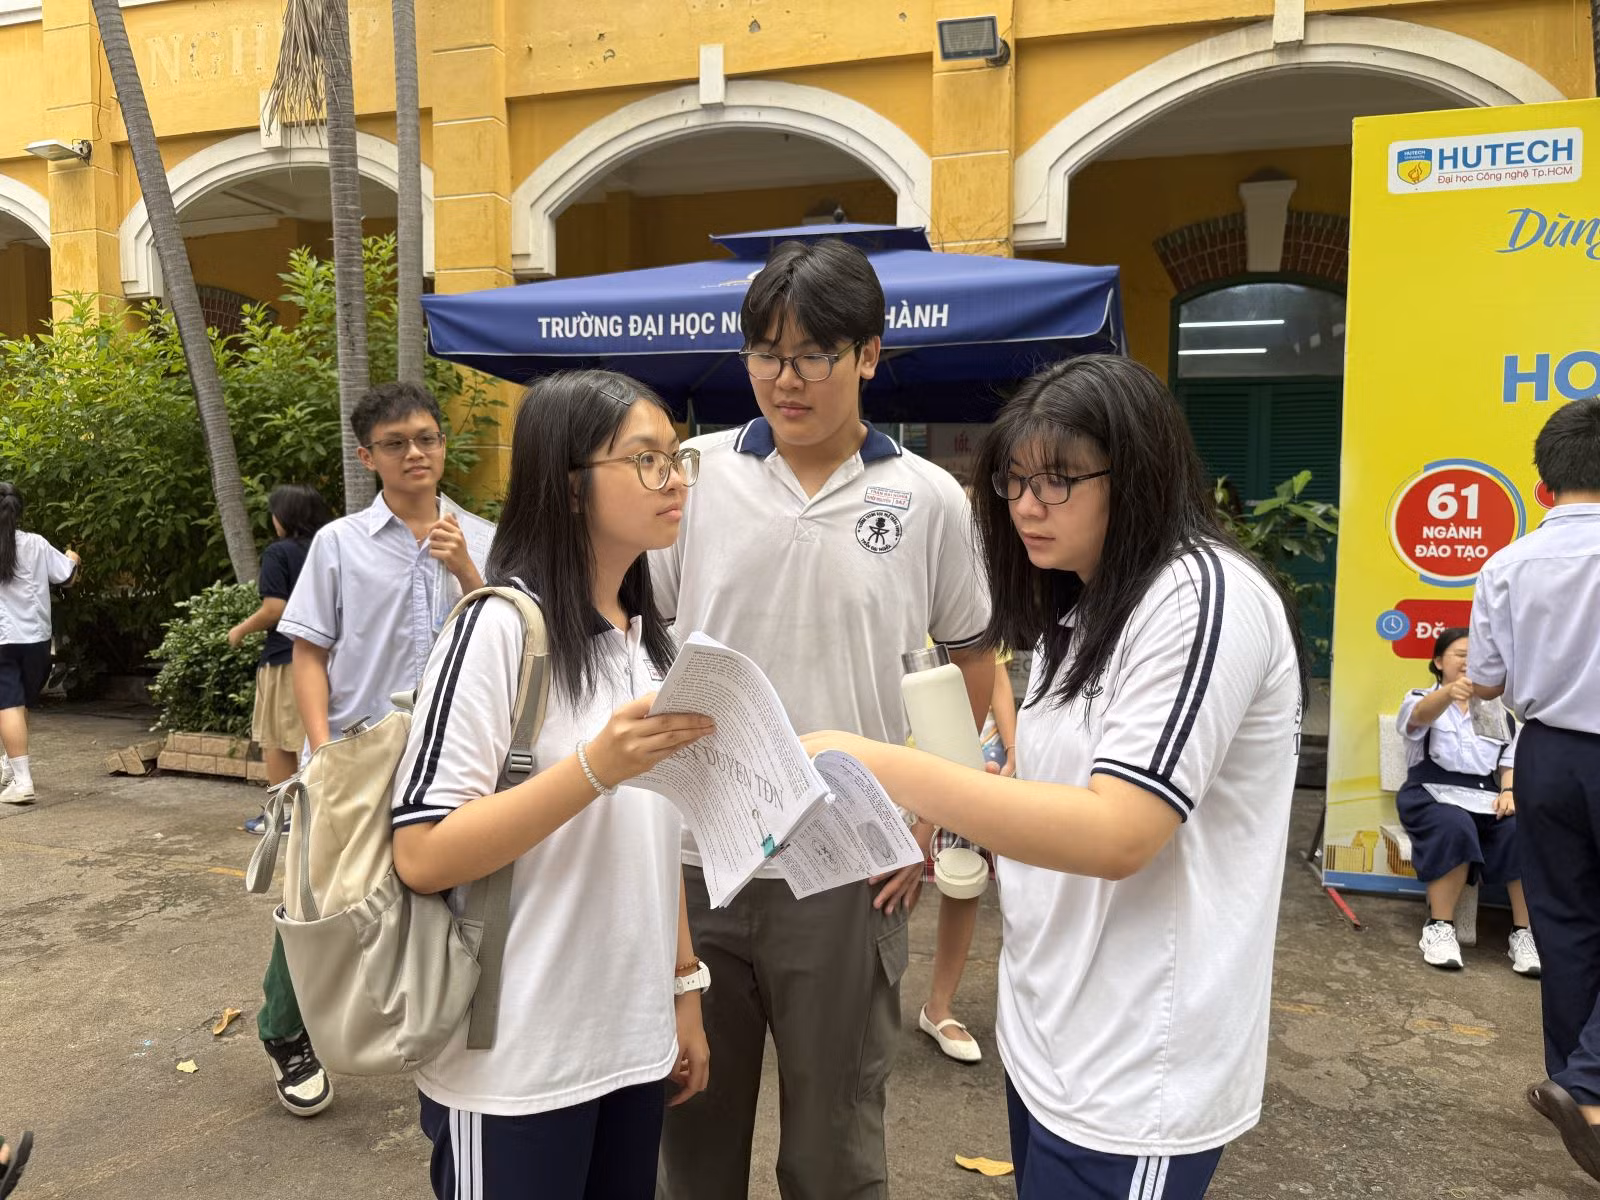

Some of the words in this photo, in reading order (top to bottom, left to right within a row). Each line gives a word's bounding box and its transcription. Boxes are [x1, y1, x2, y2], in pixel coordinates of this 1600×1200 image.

[1438, 138, 1573, 170] HUTECH
[1438, 174, 1453, 184] Đại
[1455, 173, 1474, 184] học
[1475, 171, 1502, 182] Công
[1504, 169, 1529, 180] nghệ
[1532, 166, 1573, 178] Tp.HCM
[538, 311, 623, 338] TRƯỜNG
[628, 313, 664, 341] ĐẠI
[670, 312, 716, 340] HỌC
[884, 300, 949, 329] HÀNH
[1427, 483, 1479, 520] 61
[1422, 523, 1482, 540] NGÀNH
[1414, 541, 1451, 558] ĐÀO
[1454, 544, 1489, 562] TẠO
[1415, 621, 1449, 640] Đă
